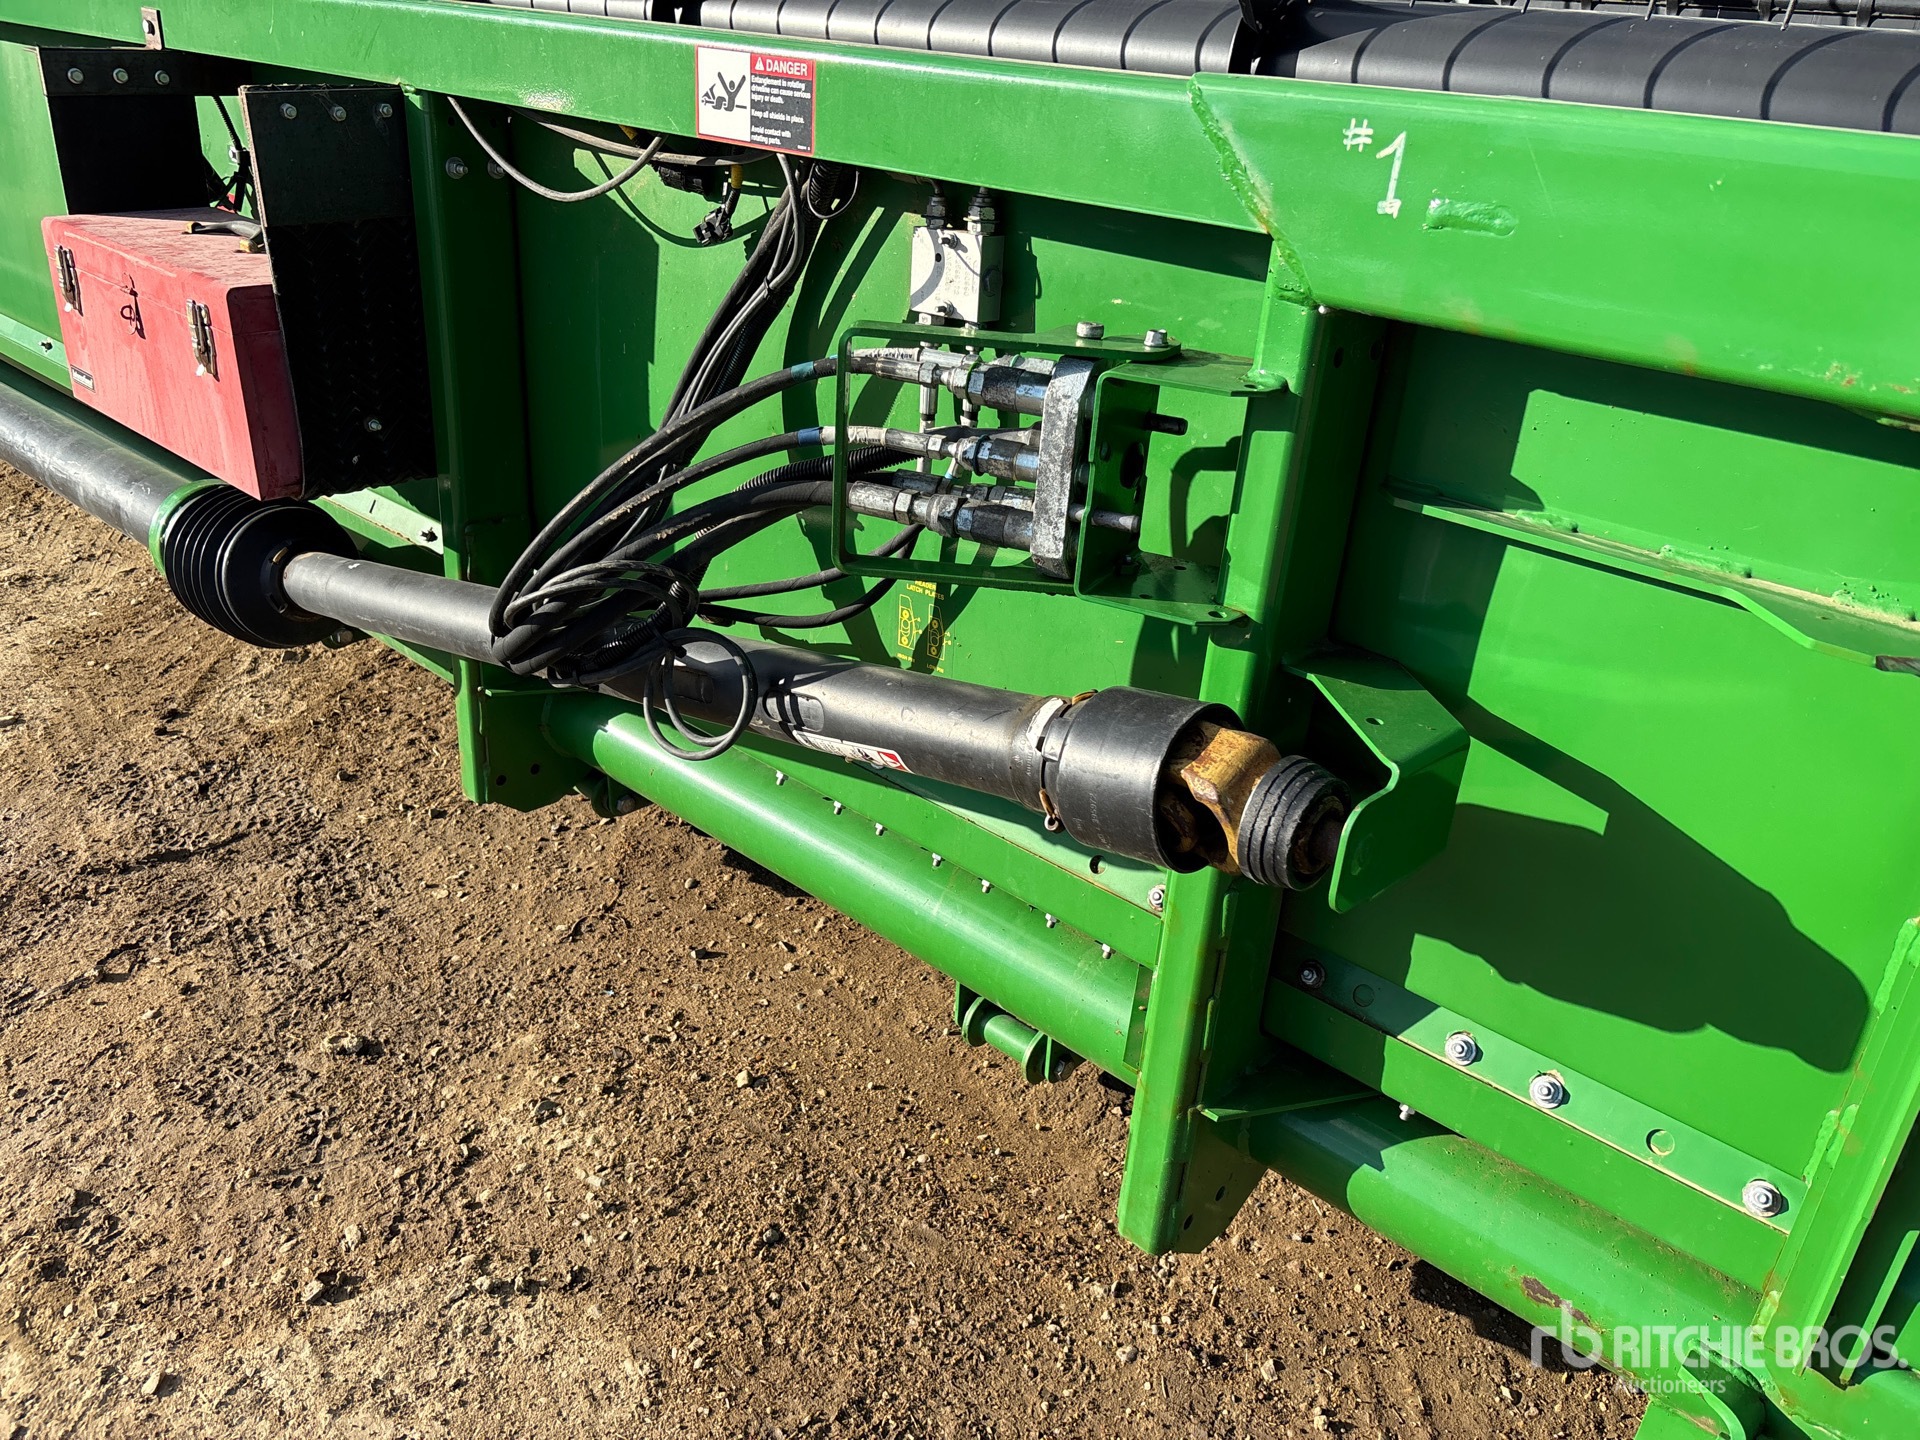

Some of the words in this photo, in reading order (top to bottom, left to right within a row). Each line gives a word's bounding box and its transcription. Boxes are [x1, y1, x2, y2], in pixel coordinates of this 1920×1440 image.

[766, 59, 808, 76] DANGER
[751, 75, 781, 86] Entanglement
[787, 80, 806, 91] rotating
[780, 88, 793, 96] cause
[794, 89, 811, 99] serious
[751, 109, 763, 119] Keep
[769, 111, 785, 121] shields
[751, 125, 764, 134] Avoid
[764, 128, 781, 137] contact
[751, 134, 768, 144] rotating
[1343, 118, 1407, 219] #1
[906, 583, 923, 594] LATCH
[924, 589, 945, 601] PLATES
